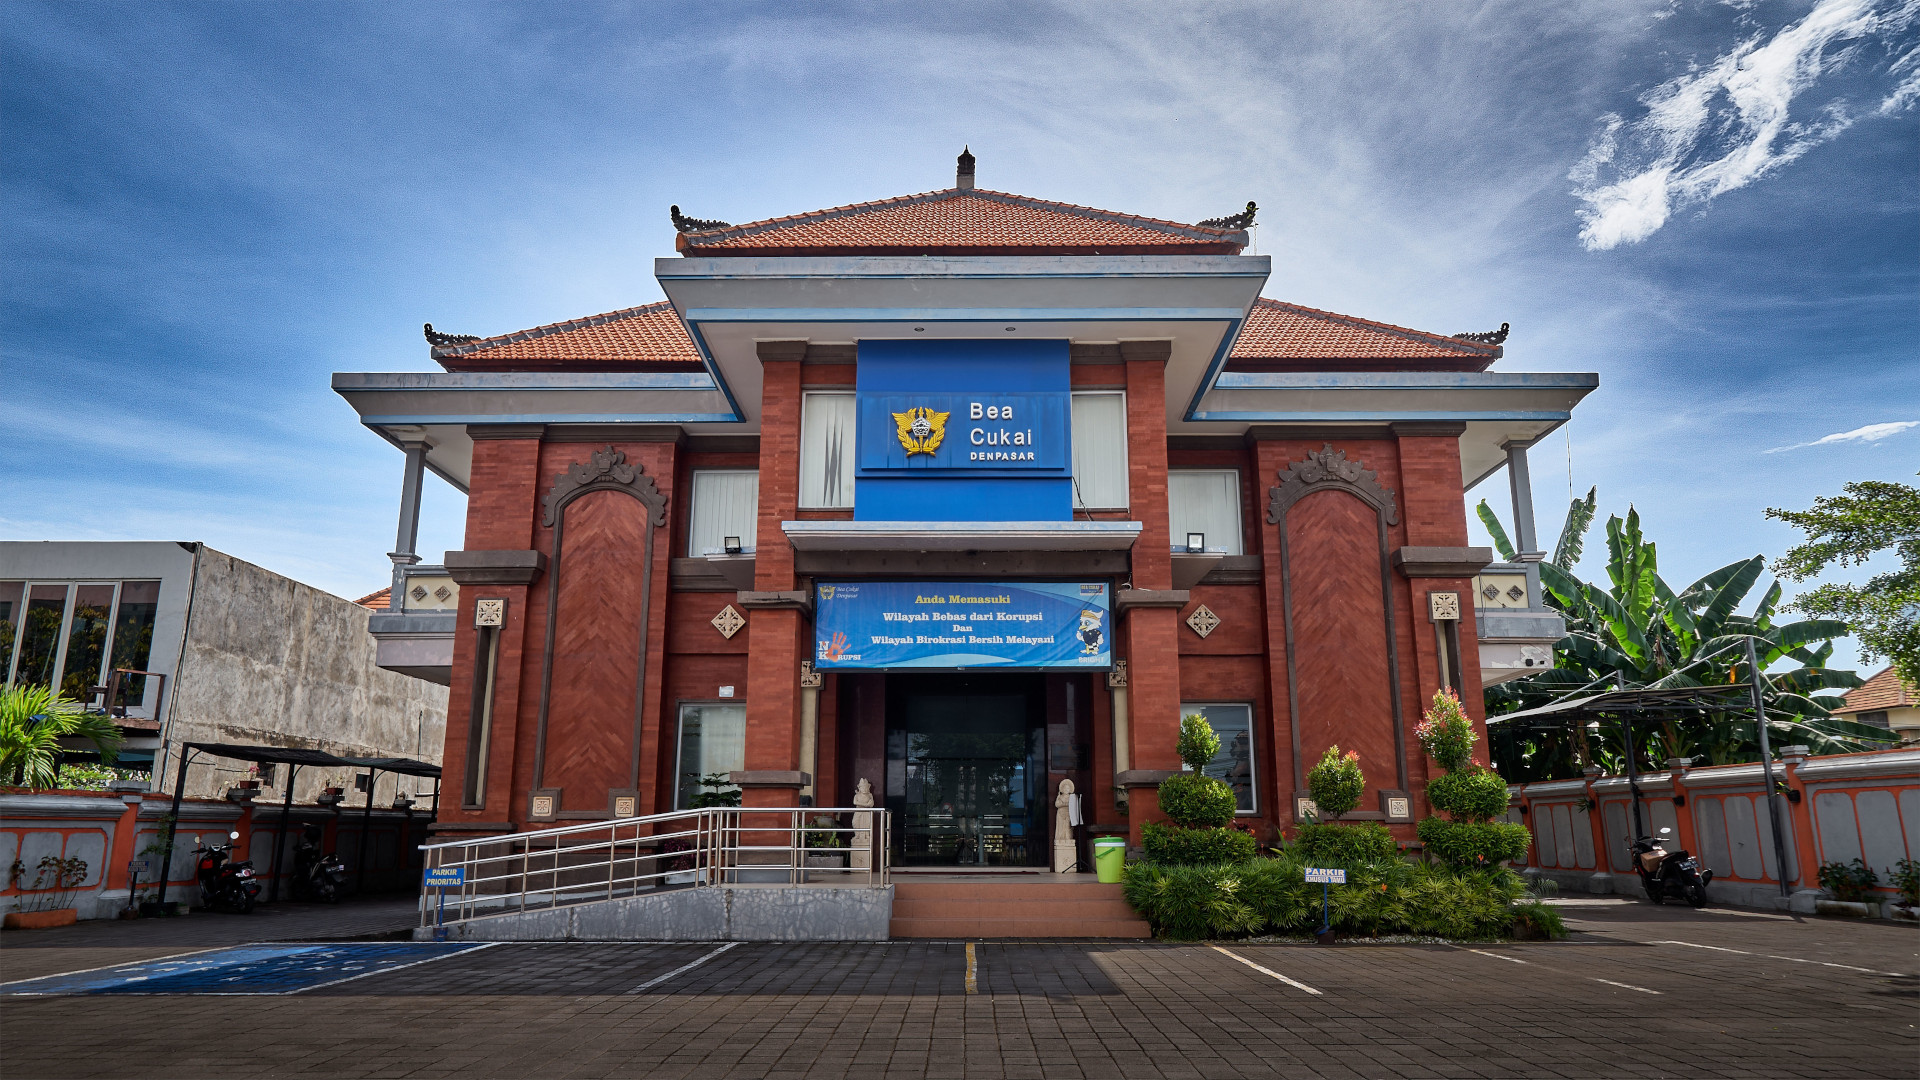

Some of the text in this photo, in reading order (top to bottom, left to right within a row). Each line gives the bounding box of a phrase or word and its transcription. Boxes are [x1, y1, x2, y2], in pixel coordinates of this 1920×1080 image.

[970, 402, 1013, 420] Bea
[970, 427, 1032, 446] Cukai
[970, 452, 1035, 461] DENPASAR
[915, 595, 1011, 604] Anda Memasuki
[882, 612, 1043, 623] Wilayah Bebas dari Korupsi
[952, 624, 973, 632] Dan
[871, 635, 1055, 646] Wilayah Birokrasi Bersih Melayani
[432, 868, 457, 876] PARKIR
[1305, 868, 1345, 876] PARKIR
[426, 878, 461, 886] PRIORITAS
